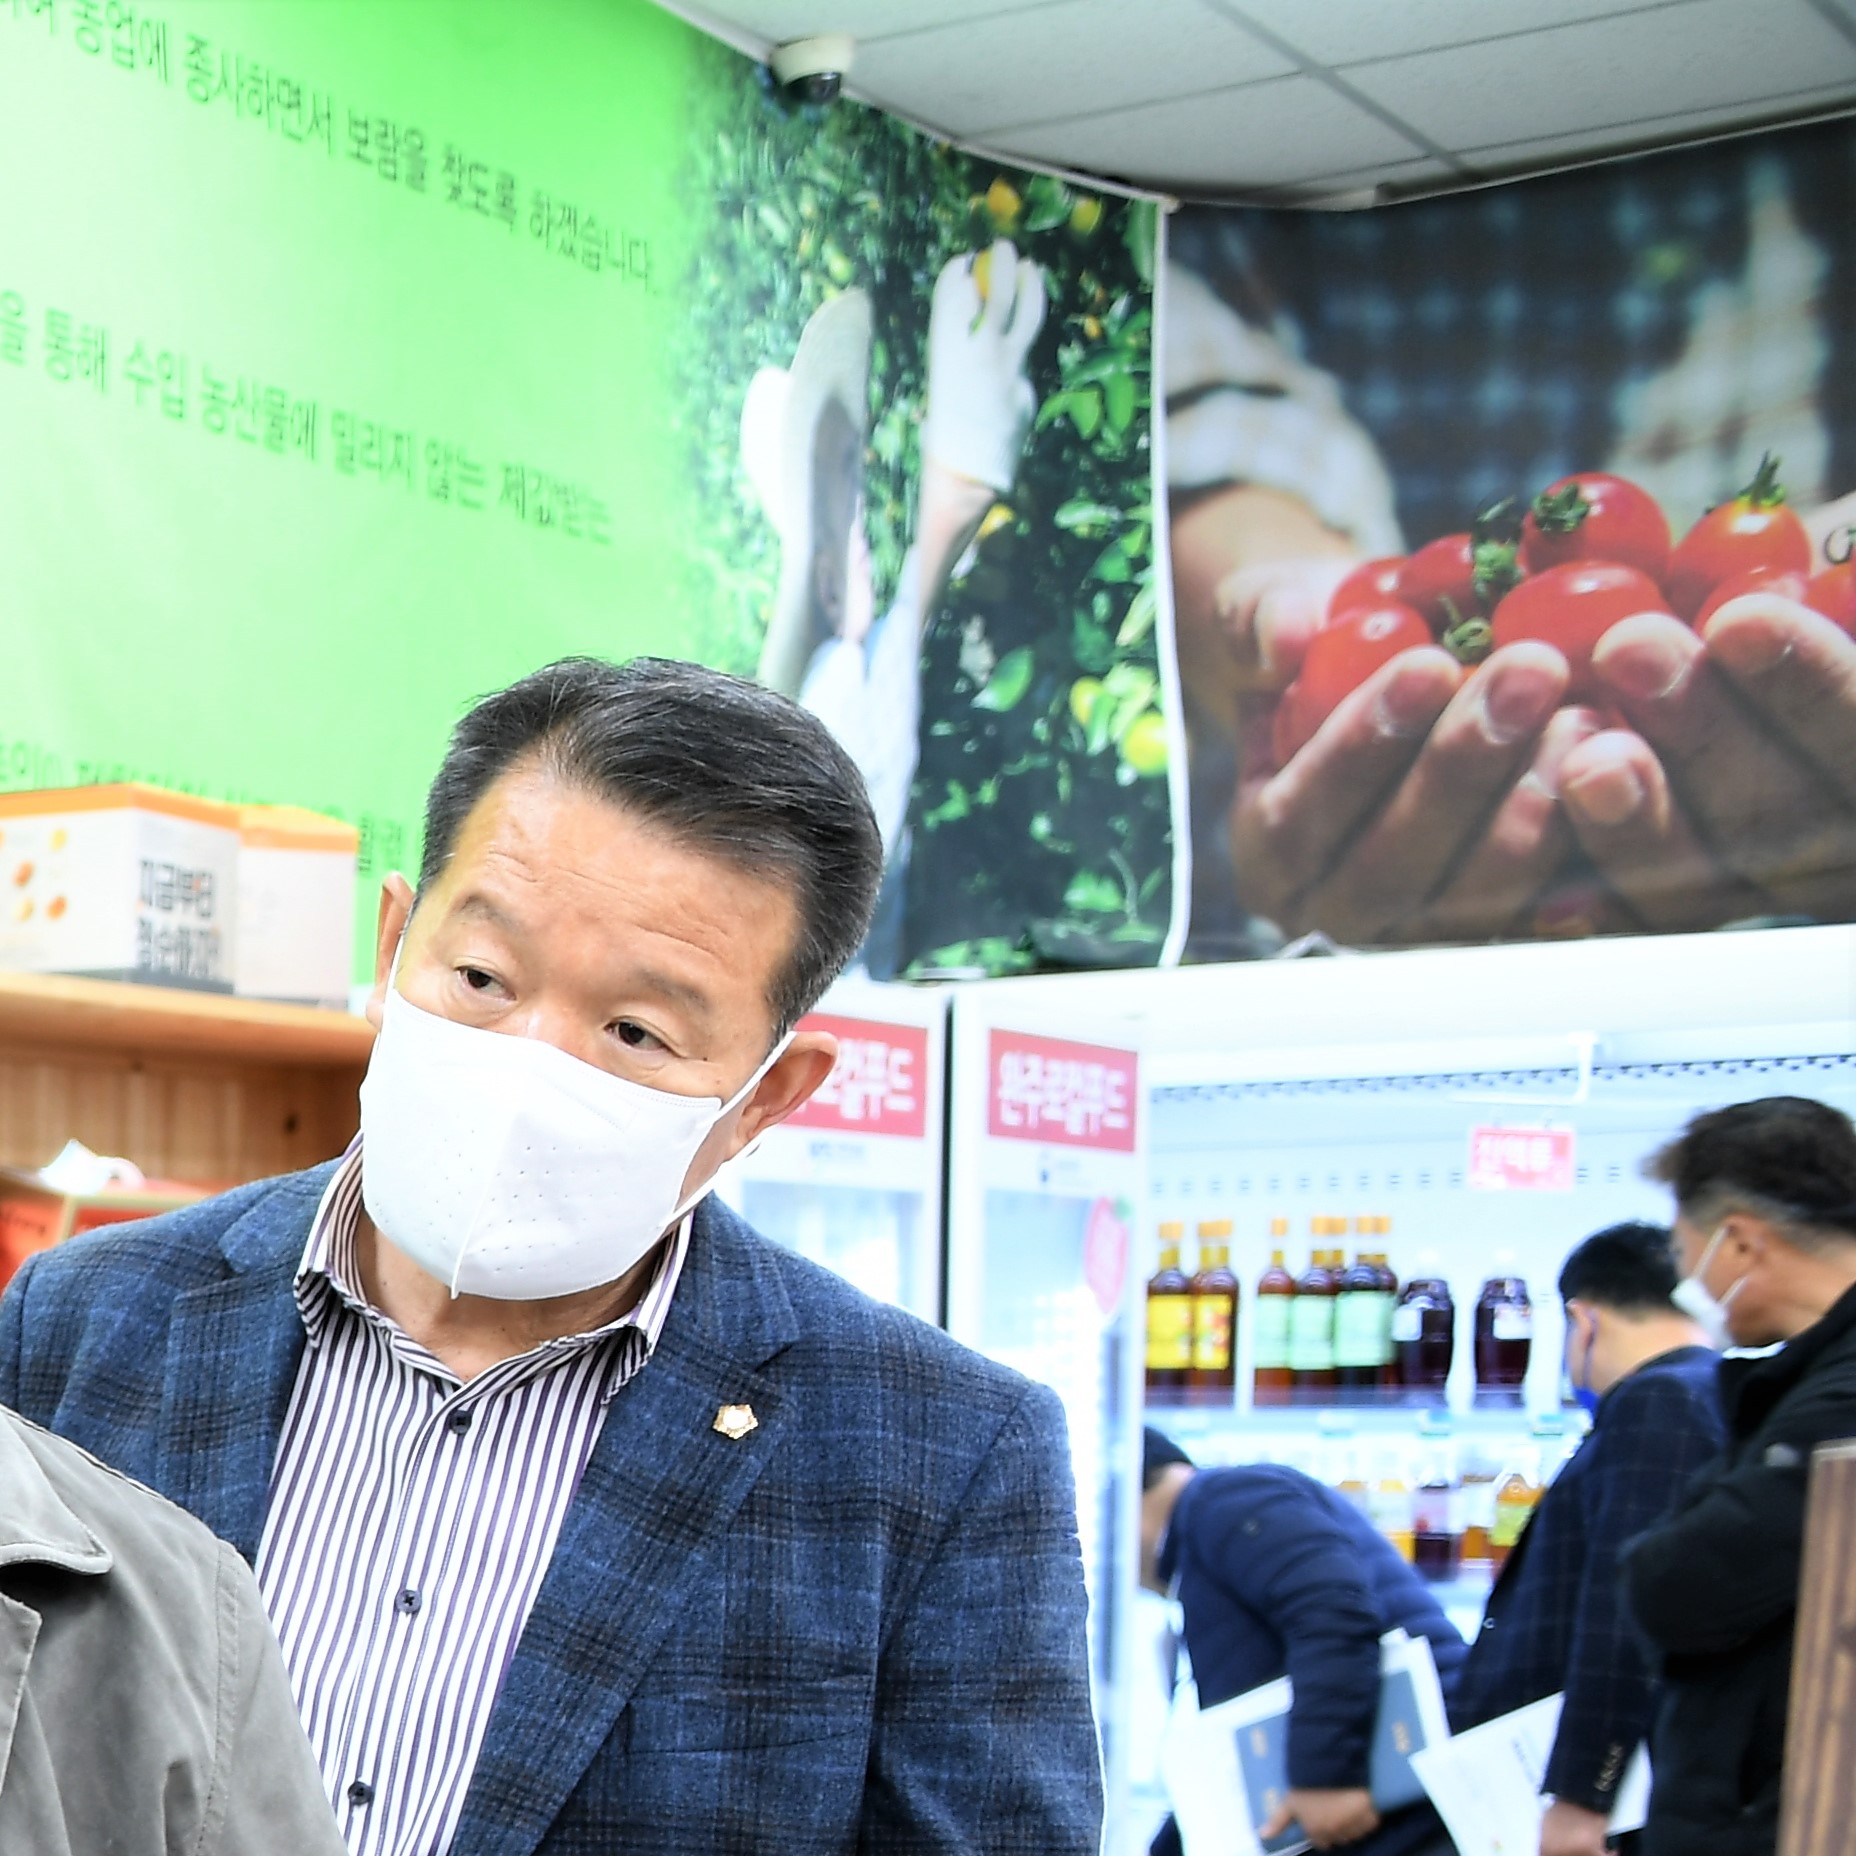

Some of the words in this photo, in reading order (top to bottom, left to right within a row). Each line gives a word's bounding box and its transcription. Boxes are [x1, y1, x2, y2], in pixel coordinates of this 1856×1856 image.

[184, 31, 334, 155] 종사하면서
[347, 106, 429, 193] 보람을
[440, 141, 518, 233] 찾도록
[43, 306, 107, 393] 통해
[122, 338, 187, 421] 수입
[199, 360, 317, 460] 농산물에
